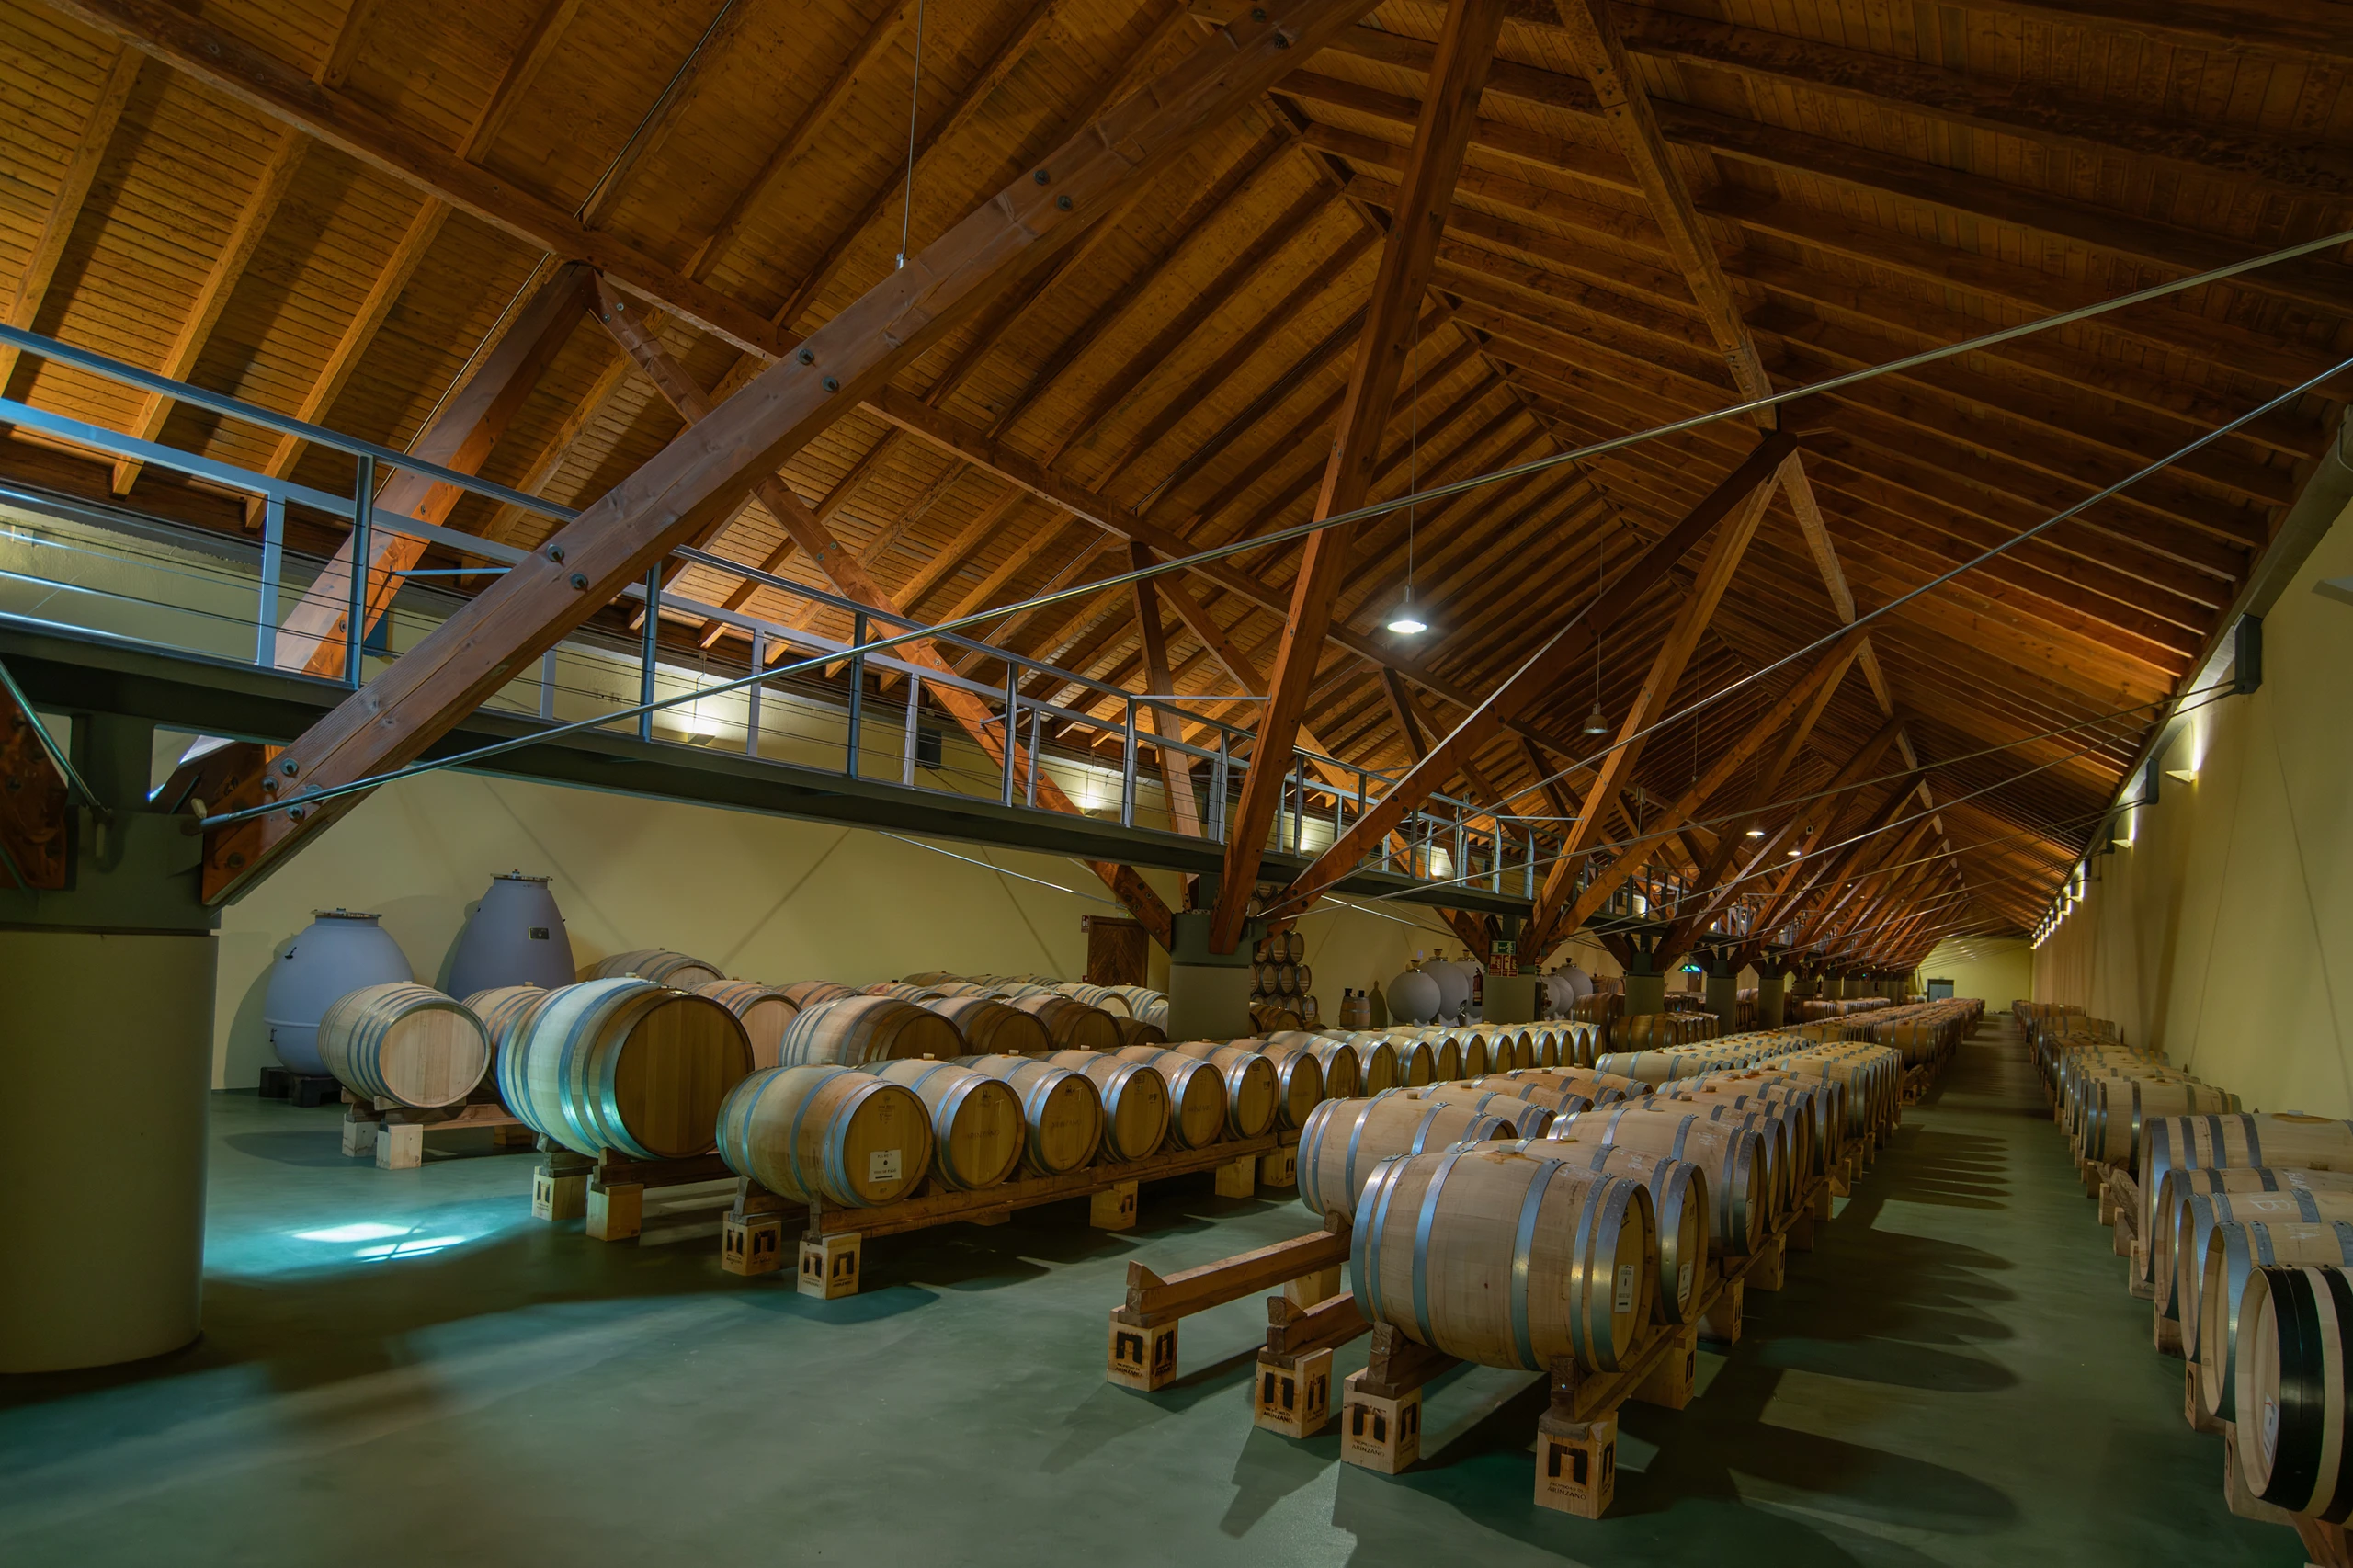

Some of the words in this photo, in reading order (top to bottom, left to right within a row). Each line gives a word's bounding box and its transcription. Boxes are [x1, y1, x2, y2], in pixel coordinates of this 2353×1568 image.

[1263, 1410, 1293, 1425] ARINZANO
[1352, 1444, 1385, 1458] ARINZANO
[1548, 1486, 1586, 1500] ARINZANO
